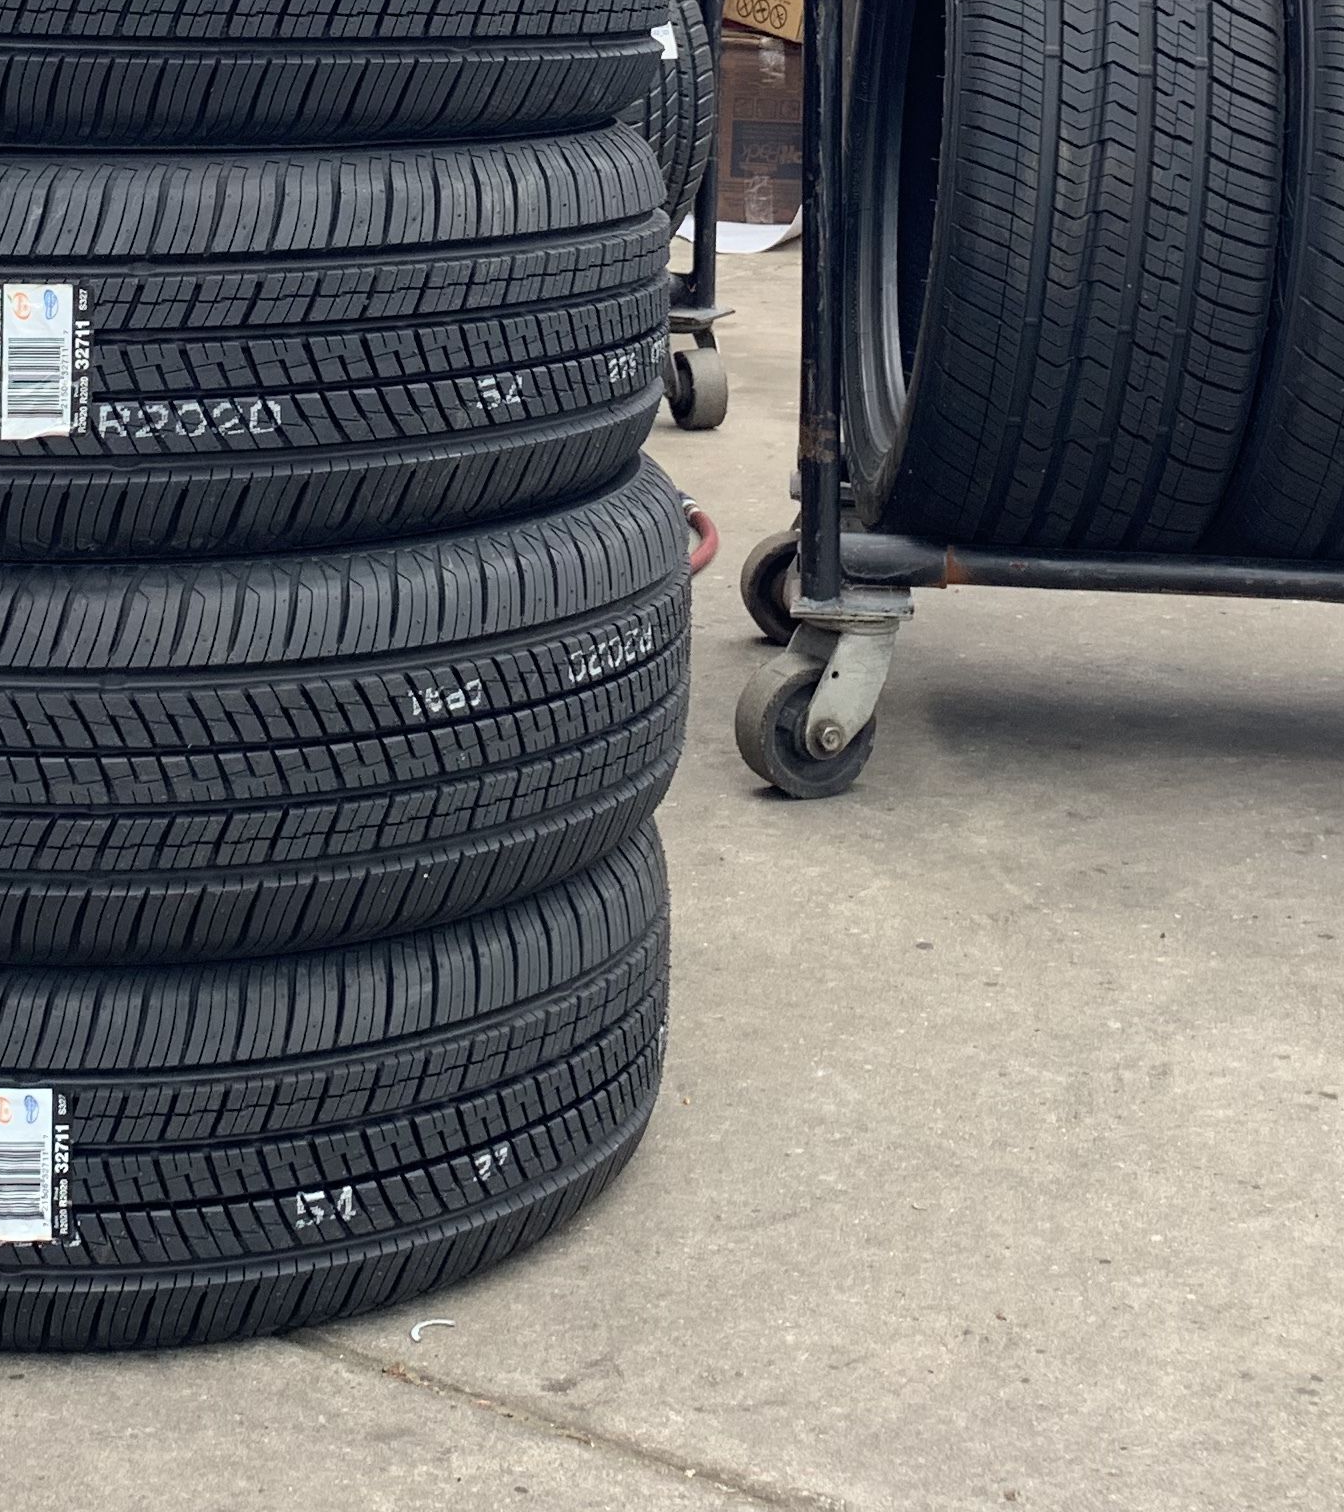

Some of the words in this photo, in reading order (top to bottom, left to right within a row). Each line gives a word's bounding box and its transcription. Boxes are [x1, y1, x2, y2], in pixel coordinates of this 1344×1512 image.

[74, 320, 91, 370] 32711
[79, 376, 89, 404] R2020
[98, 398, 283, 439] R2020
[54, 1124, 69, 1174] 32711
